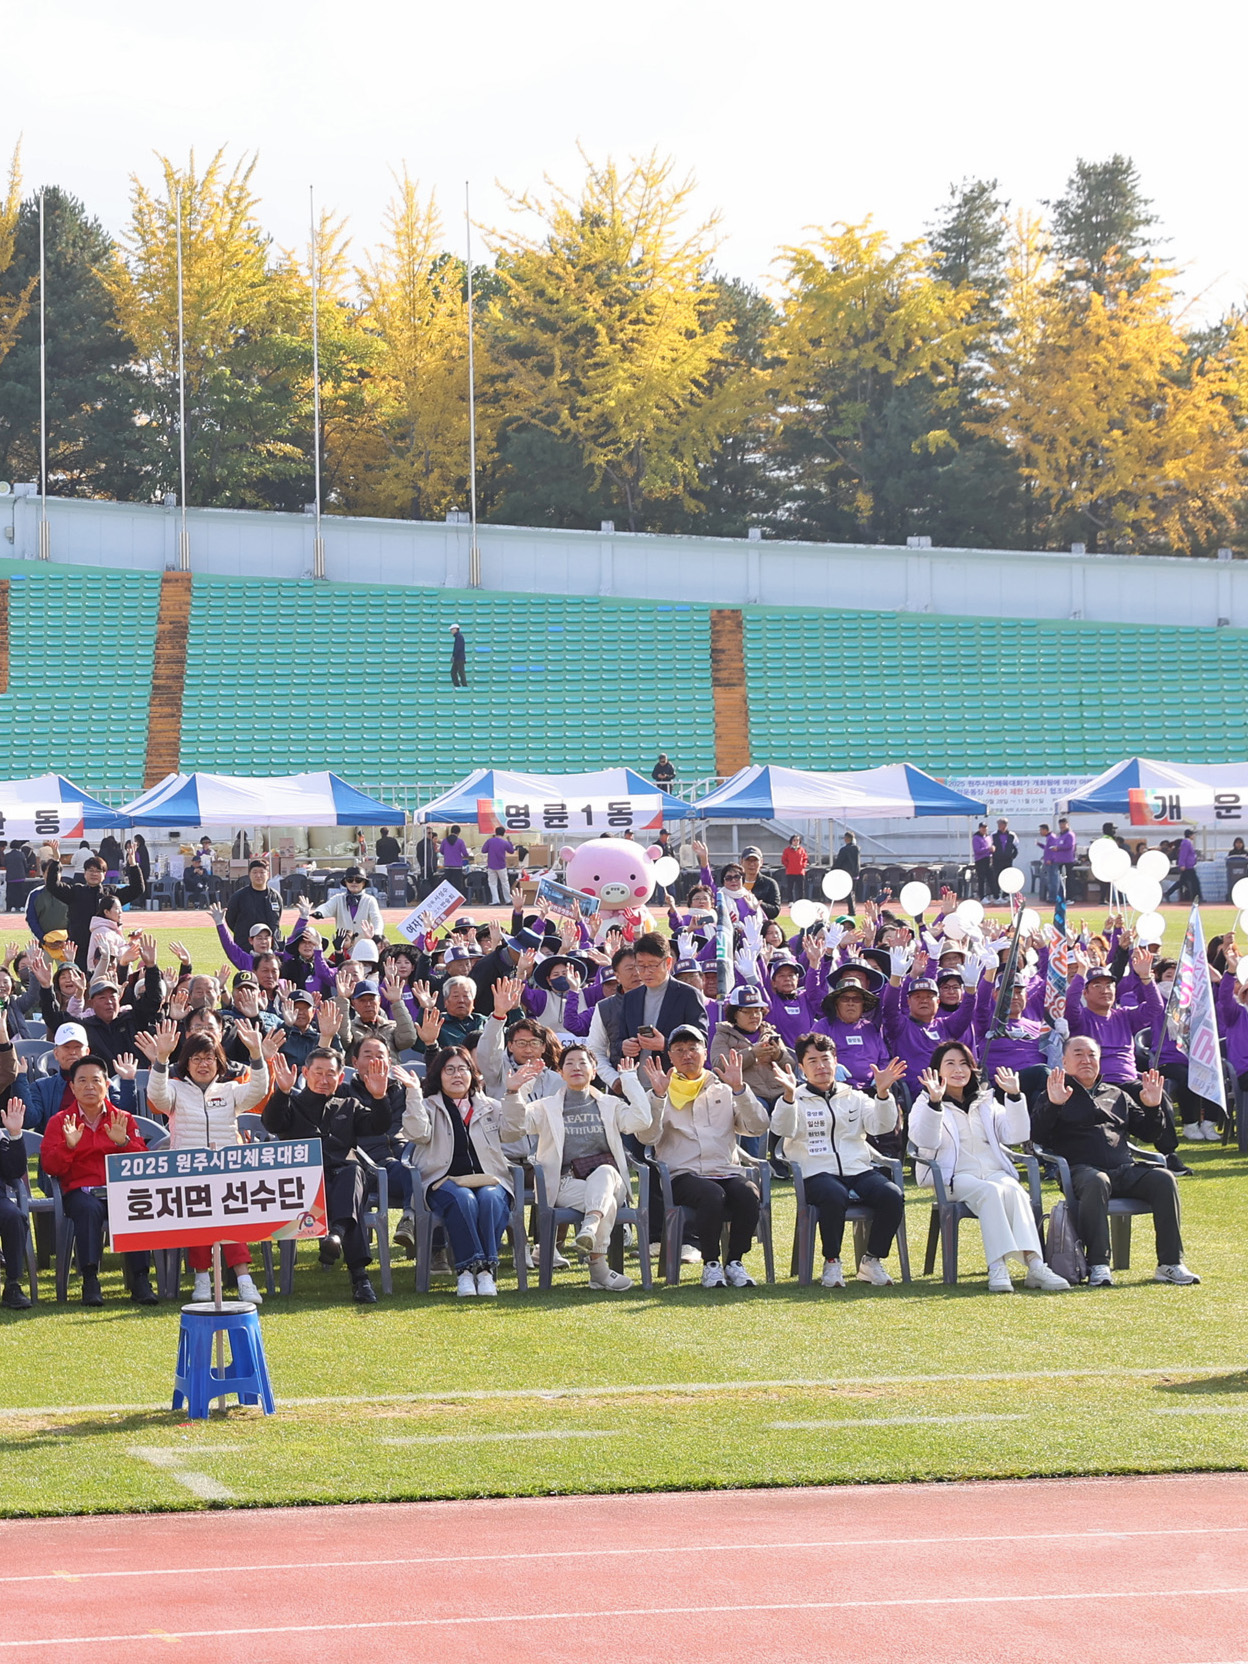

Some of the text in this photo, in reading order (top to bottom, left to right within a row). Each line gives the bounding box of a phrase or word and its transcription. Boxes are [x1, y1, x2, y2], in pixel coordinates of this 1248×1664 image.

[505, 801, 633, 830] 명륜1동
[121, 1143, 309, 1177] 2025 원주시민체육대회
[127, 1176, 306, 1222] 호저면 선수단
